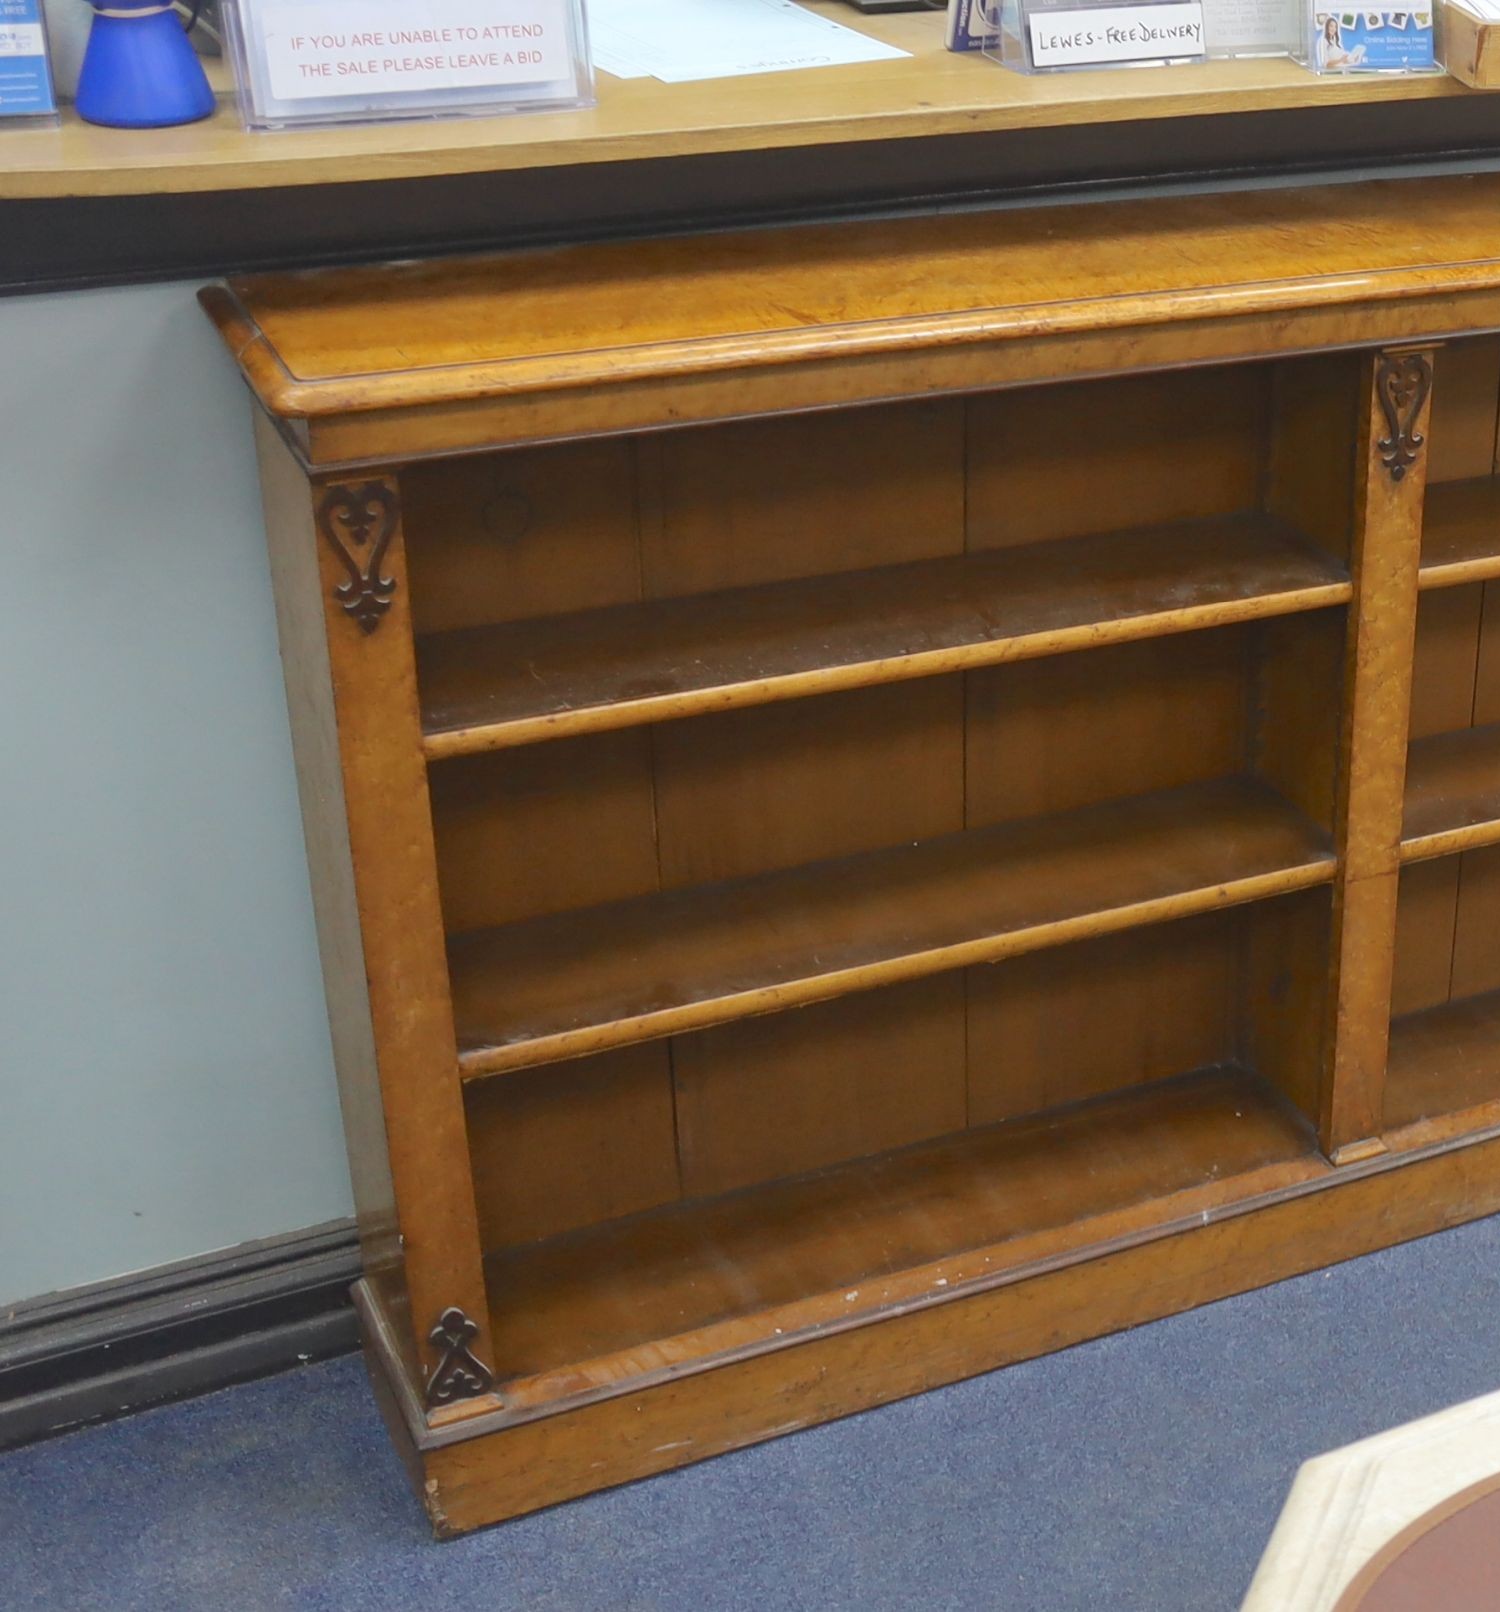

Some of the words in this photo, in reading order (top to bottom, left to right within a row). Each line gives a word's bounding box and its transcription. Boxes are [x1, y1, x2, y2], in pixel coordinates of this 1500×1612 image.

[291, 36, 305, 51] IF
[309, 34, 346, 49] YOU
[350, 31, 385, 47] ARE
[388, 28, 452, 46] UNABLE
[456, 27, 479, 41] TO
[482, 24, 544, 40] ATTEND
[298, 62, 333, 78] THE
[336, 60, 378, 76] SALE
[383, 56, 445, 73] PLEASE
[448, 53, 499, 69] LEAVE
[501, 52, 515, 66] A
[517, 50, 544, 64] BID
